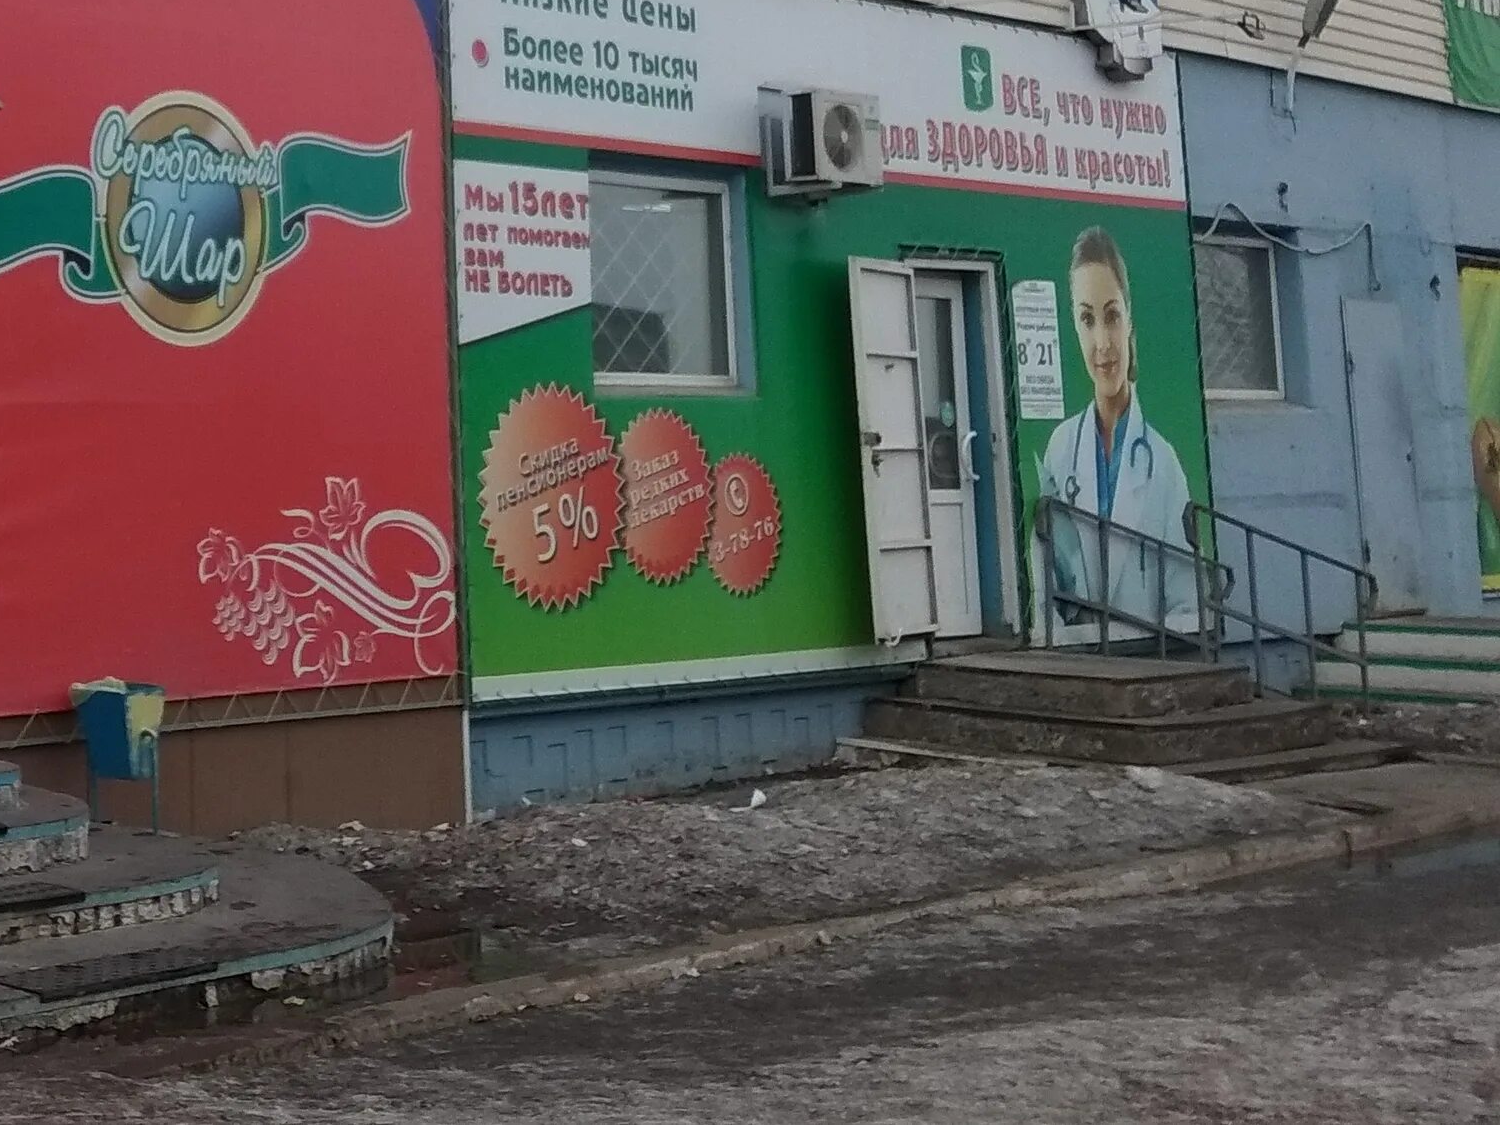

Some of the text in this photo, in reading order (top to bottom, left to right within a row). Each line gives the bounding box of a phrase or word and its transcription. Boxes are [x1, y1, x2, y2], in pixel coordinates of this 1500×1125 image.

[503, 27, 698, 82] Более 10 тысяч
[504, 65, 695, 113] наименований
[1002, 73, 1167, 140] ВСЕ, что нужно
[96, 111, 277, 200] Серебряный
[925, 119, 1049, 175] ЗДОРОВЬЯ
[1074, 147, 1172, 190] красоты!
[464, 183, 504, 213] Мы
[119, 199, 246, 307] Шар
[463, 222, 499, 243] лет
[465, 268, 573, 297] НЕ БОЛЕТЬ
[496, 447, 611, 513] пенсионерам
[518, 437, 579, 477] Скидка
[631, 450, 680, 482] Заказ
[713, 515, 775, 563] 3-78-76
